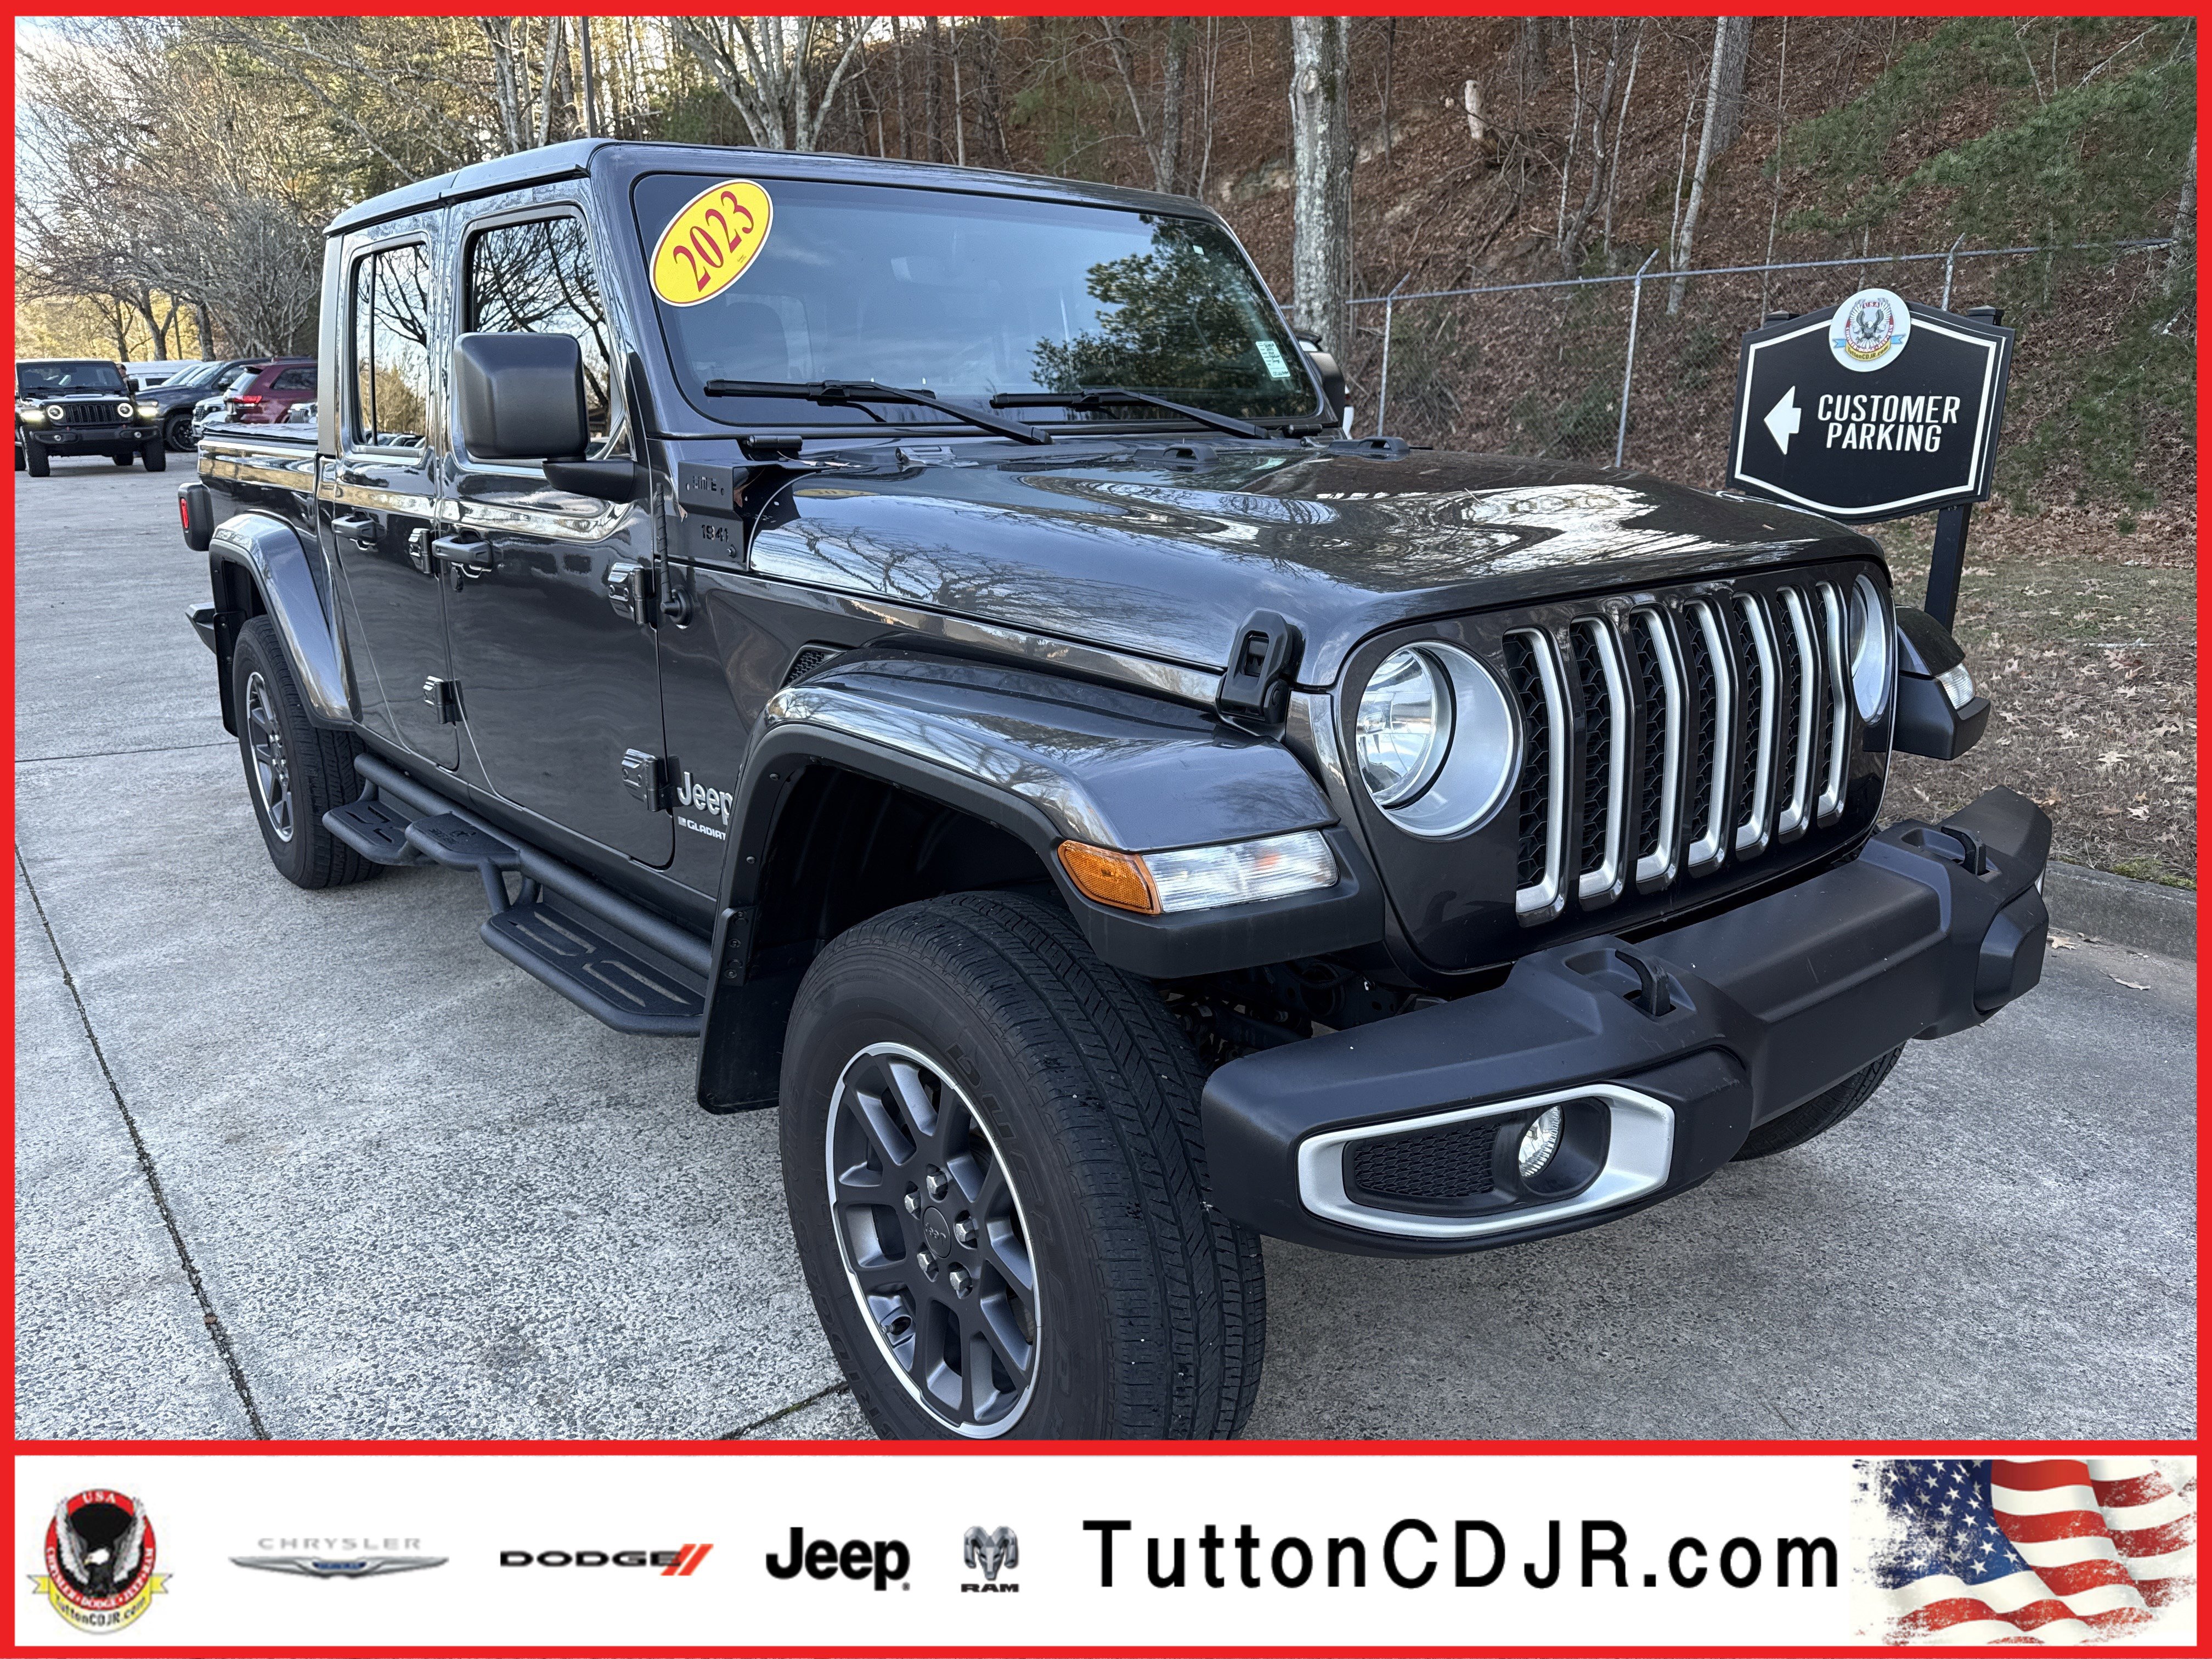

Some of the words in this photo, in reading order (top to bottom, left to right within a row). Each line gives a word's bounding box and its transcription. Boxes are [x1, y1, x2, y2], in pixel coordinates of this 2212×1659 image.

[673, 190, 754, 292] 2023
[1818, 394, 1961, 424] CUSTOMER
[1826, 422, 1943, 453] PARKING
[701, 524, 730, 543] 1941
[677, 771, 733, 826] Jeep
[687, 819, 726, 842] GLADIAT
